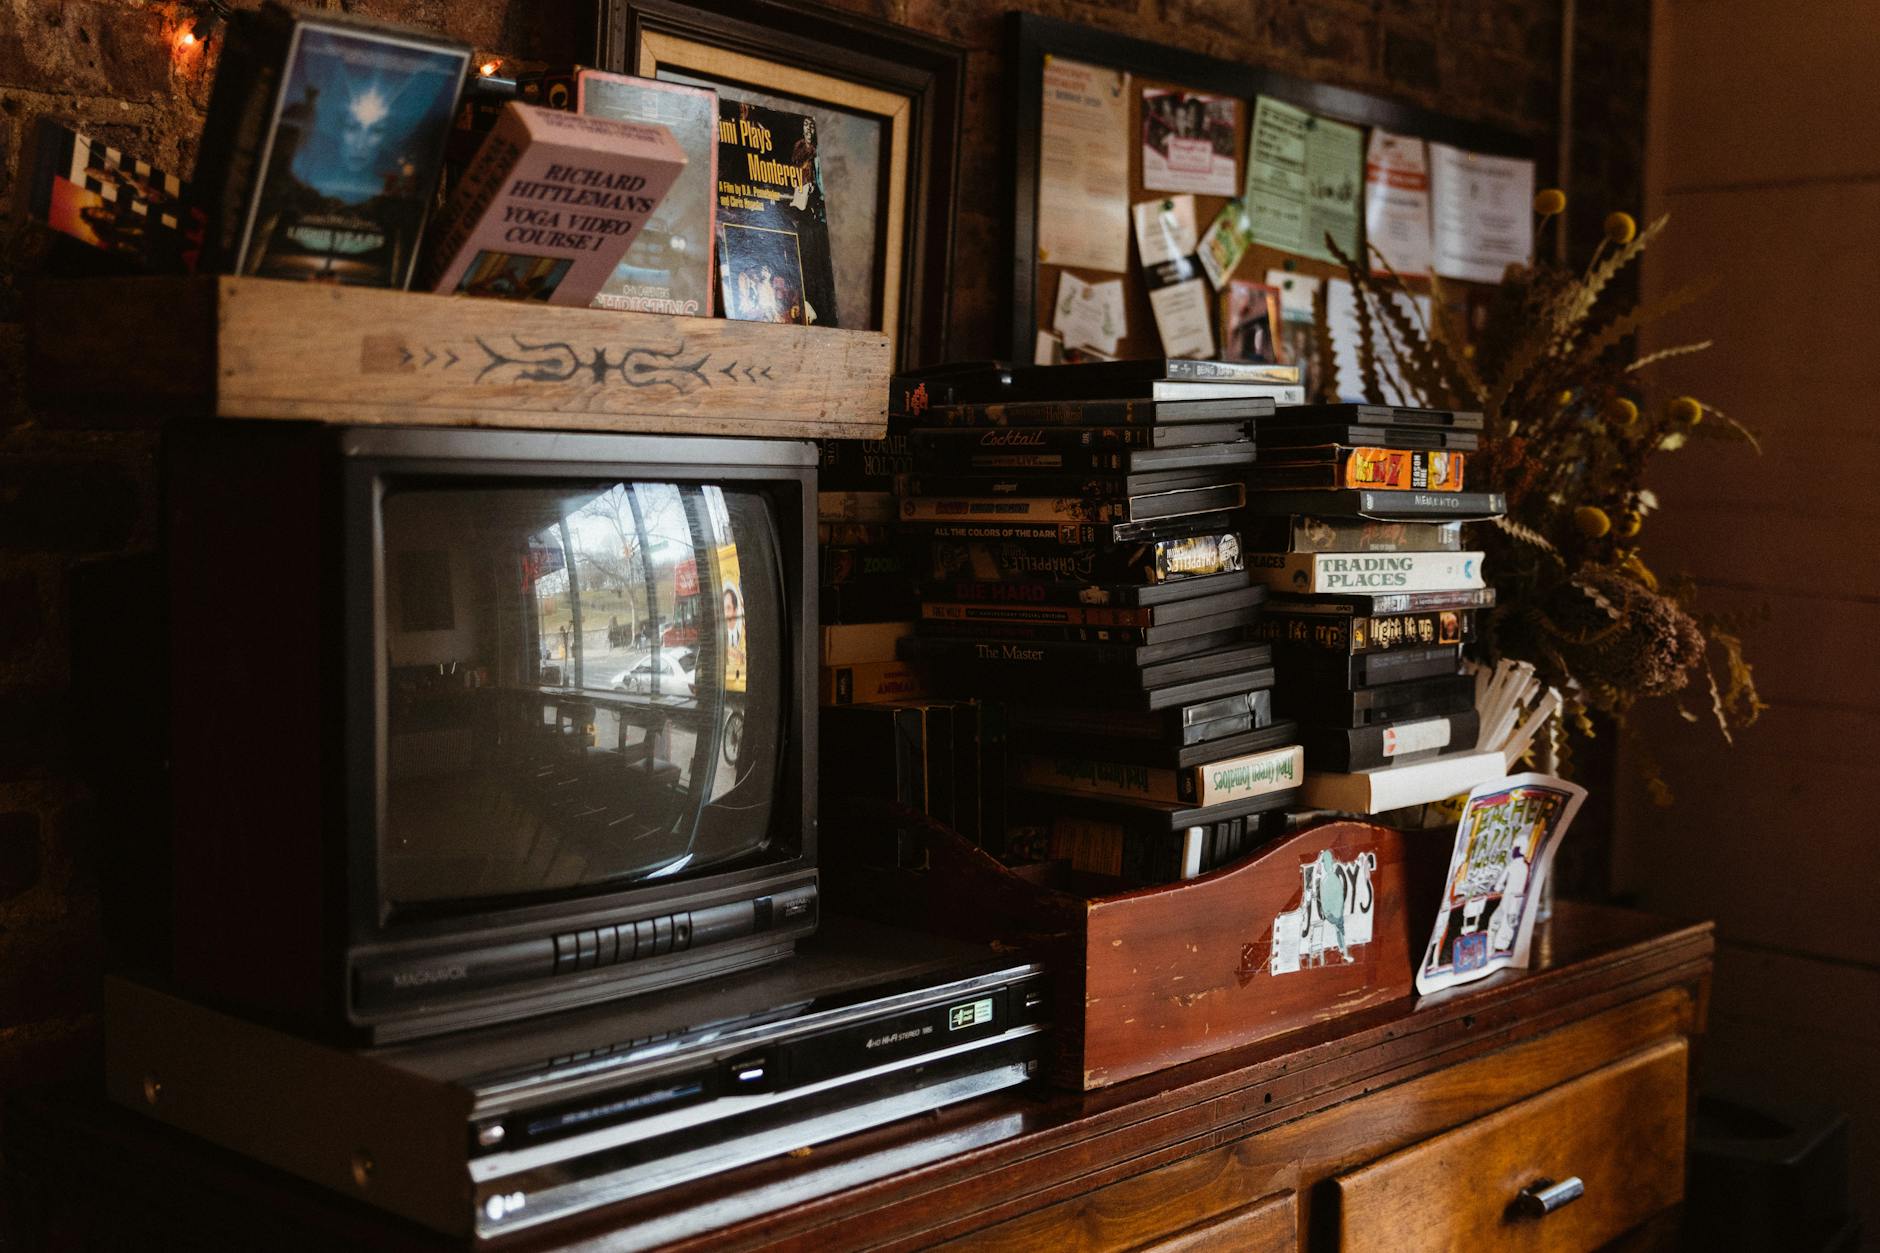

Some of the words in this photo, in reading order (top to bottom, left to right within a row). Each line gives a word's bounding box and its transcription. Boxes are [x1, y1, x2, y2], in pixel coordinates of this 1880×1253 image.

[718, 117, 738, 146] imi
[739, 118, 773, 154] Plays
[543, 164, 646, 193] RICHARD
[747, 153, 803, 193] Monterey
[509, 180, 655, 214] HITTLEMAN'S
[723, 182, 735, 194] Film
[735, 184, 742, 197] by
[719, 195, 730, 206] and
[730, 196, 744, 209] Chris
[504, 205, 560, 229] YOGA
[567, 213, 632, 237] VIDEO
[505, 227, 592, 251] COURSE
[980, 431, 1046, 446] Cocktail
[935, 527, 950, 538] ALL
[951, 528, 966, 538] THE
[968, 528, 1001, 538] COLORS
[1002, 529, 1013, 539] OF
[1015, 529, 1031, 539] THE
[1033, 530, 1057, 539] DARK
[1001, 552, 1075, 575] CHAPPELLE'S
[1167, 550, 1217, 573] CHAPPELLE'S
[1247, 556, 1285, 569] PLACES
[1319, 558, 1413, 573] TRADING
[955, 582, 985, 600] DIE
[992, 582, 1047, 600] HARD
[1327, 573, 1406, 588] PLACES
[1370, 618, 1402, 648] light
[1404, 617, 1417, 642] it
[1418, 619, 1434, 643] up
[975, 644, 999, 659] The
[1002, 644, 1045, 661] Master
[1213, 766, 1251, 794] Tomatoes
[1252, 760, 1276, 785] Green
[1276, 756, 1294, 783] Fried
[898, 1029, 920, 1041] STEREO
